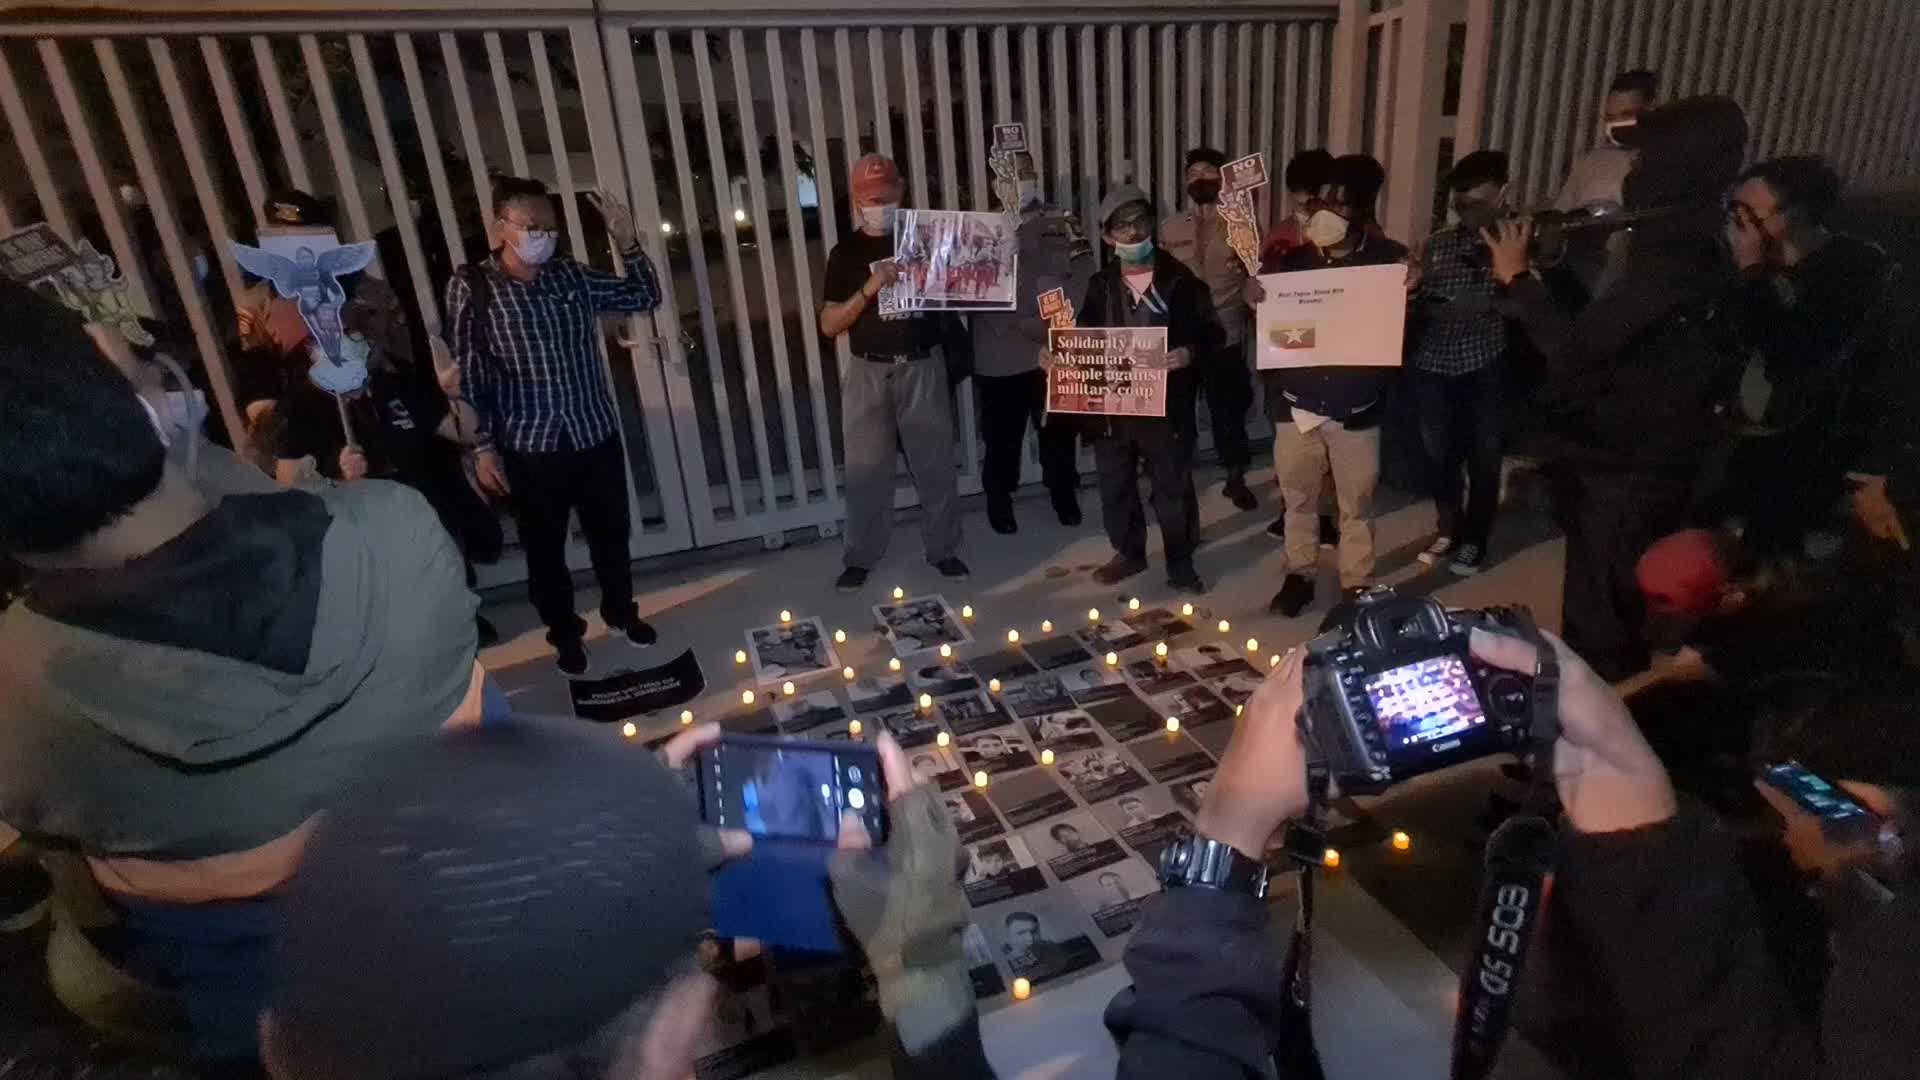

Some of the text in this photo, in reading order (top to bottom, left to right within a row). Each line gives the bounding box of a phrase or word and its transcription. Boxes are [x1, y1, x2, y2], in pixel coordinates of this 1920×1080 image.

[1232, 159, 1255, 172] NO
[1057, 335, 1154, 352] Solidarity for
[1056, 351, 1136, 367] Myanmar's
[1057, 368, 1160, 382] people against
[1057, 382, 1153, 399] military coup
[1487, 884, 1530, 955] EOS
[1480, 953, 1513, 995] 5D
